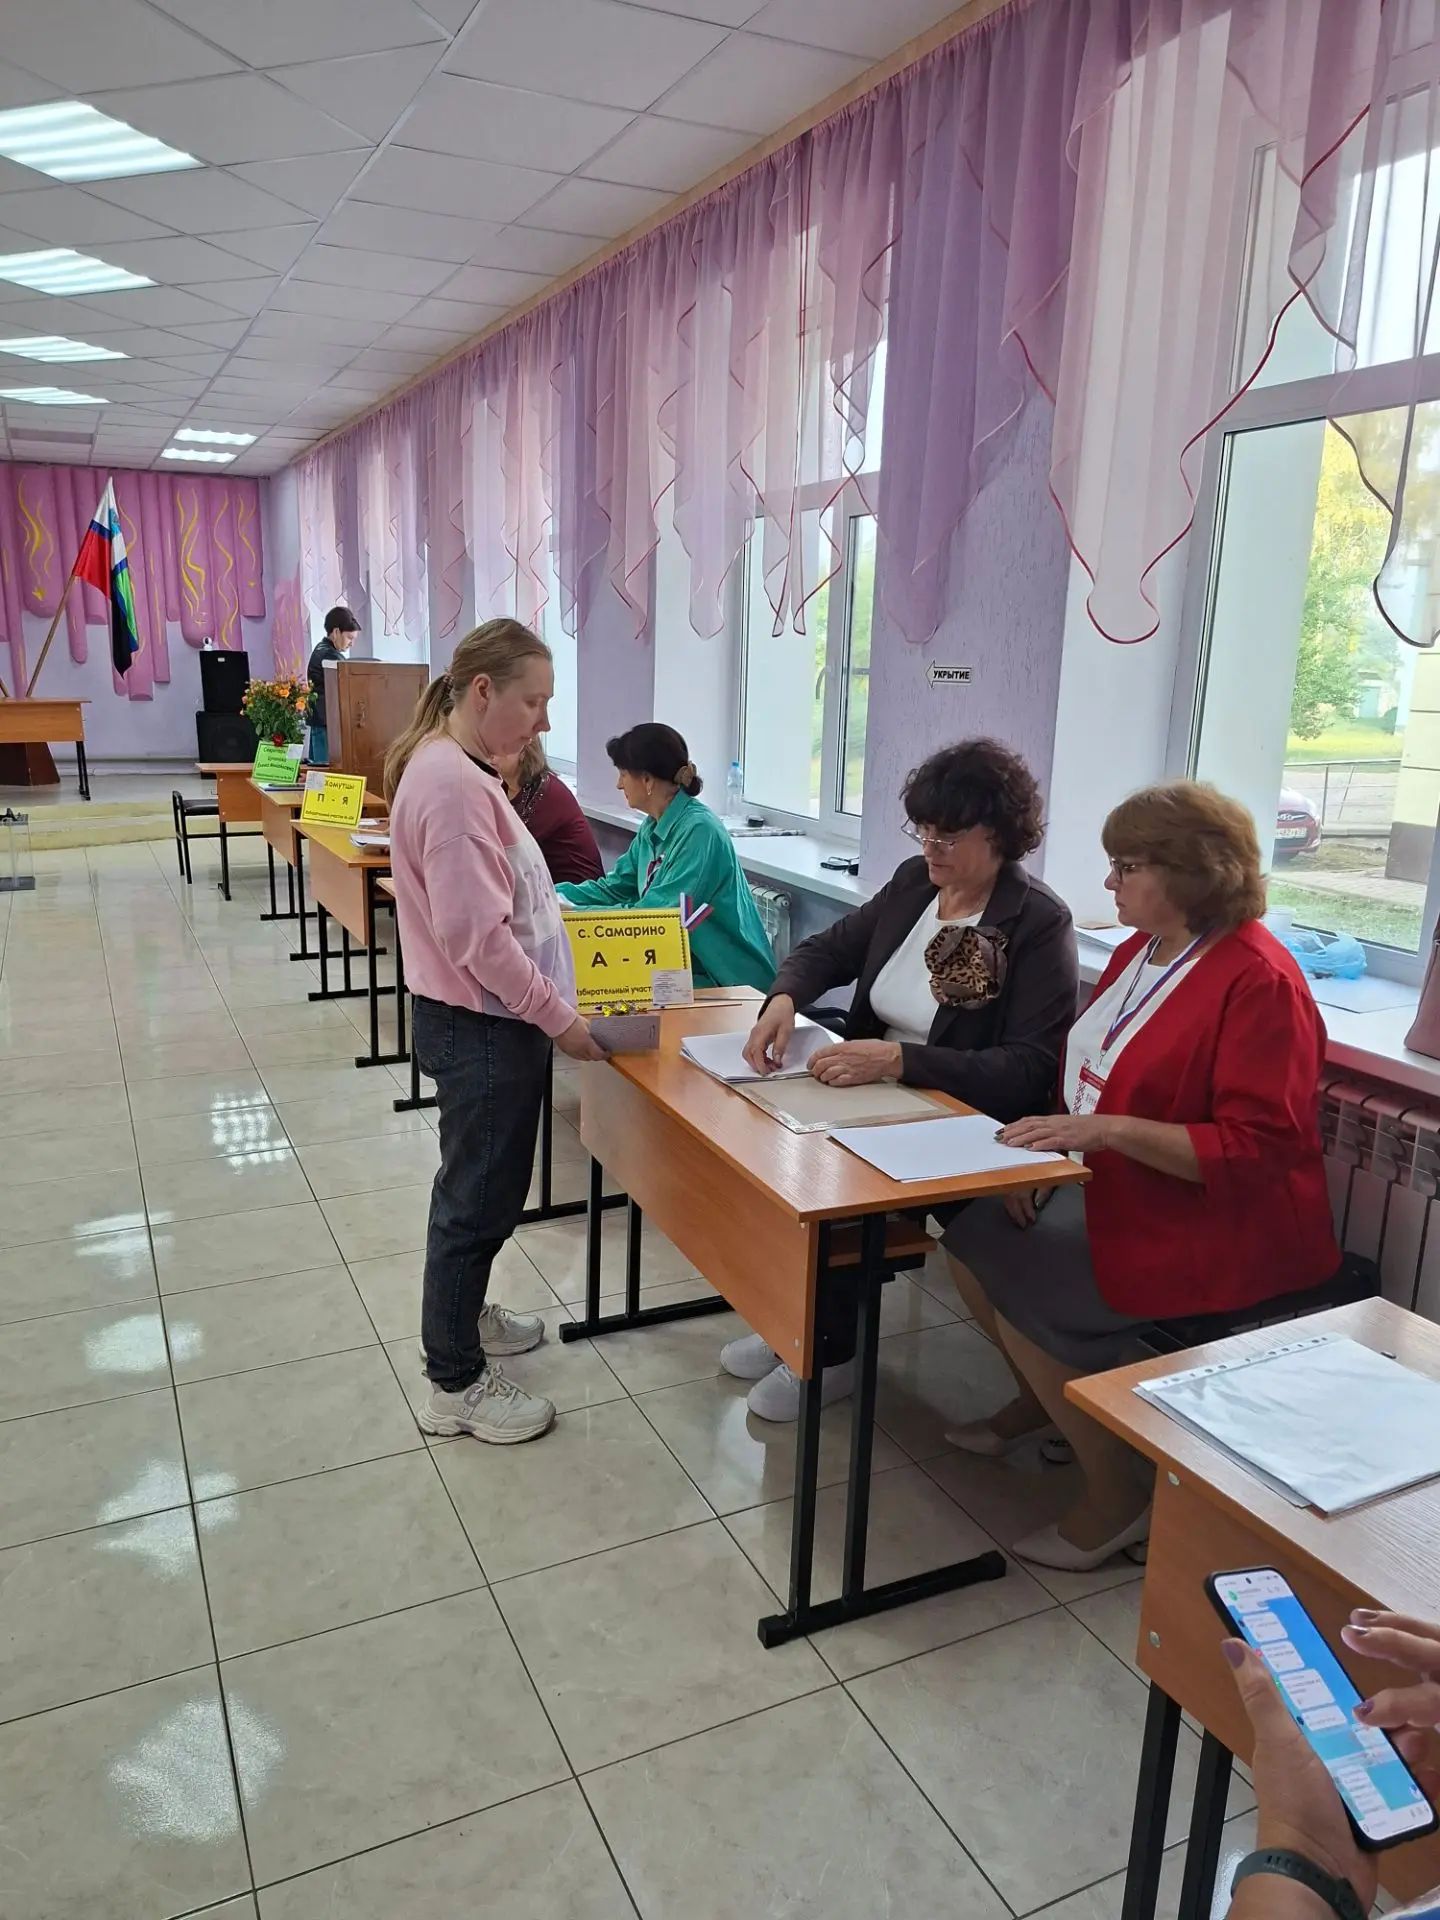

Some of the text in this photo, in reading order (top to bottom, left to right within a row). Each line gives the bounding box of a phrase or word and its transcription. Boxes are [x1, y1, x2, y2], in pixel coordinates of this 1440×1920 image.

[933, 671, 970, 679] УКРЫТИЕ
[317, 793, 324, 802] П
[342, 796, 348, 805] Я
[578, 925, 666, 939] с. Самарино
[591, 952, 608, 967] А
[644, 949, 657, 965] Я
